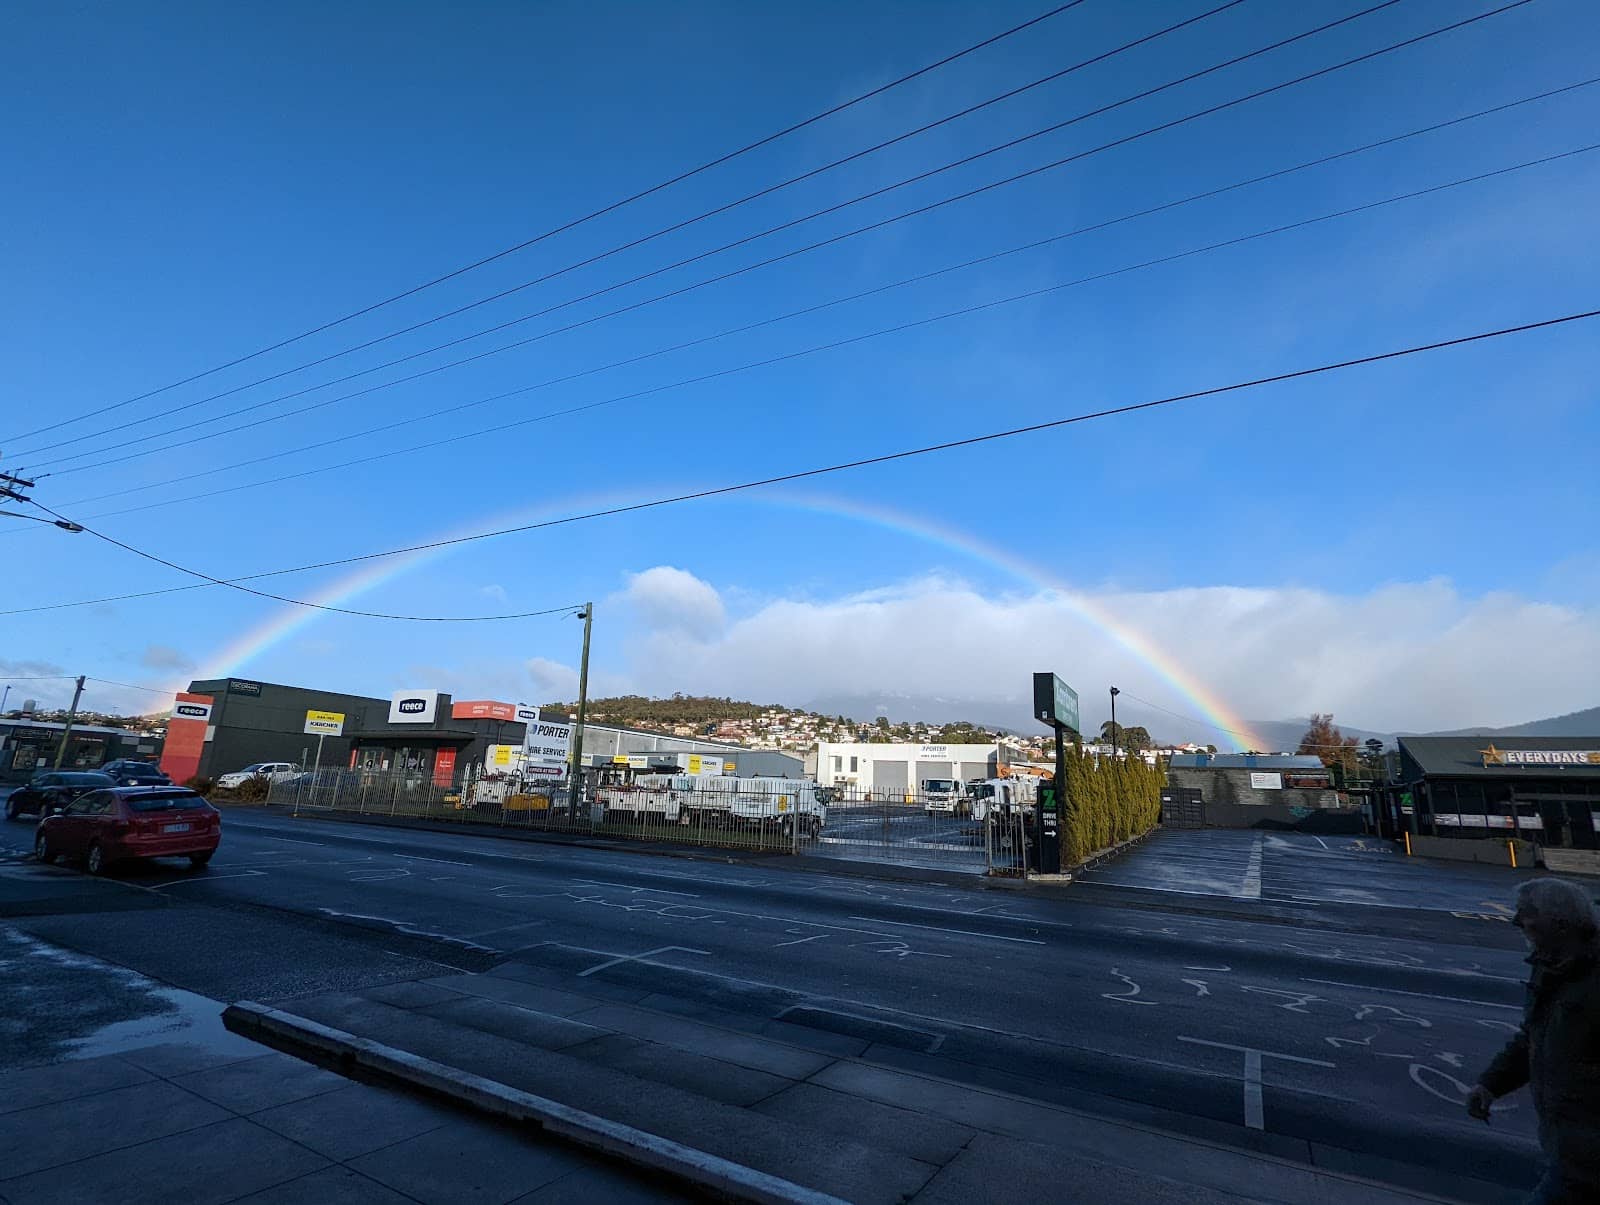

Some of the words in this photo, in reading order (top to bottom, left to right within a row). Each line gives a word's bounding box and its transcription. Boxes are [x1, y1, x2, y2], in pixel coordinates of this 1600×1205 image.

[180, 707, 205, 715] reece
[402, 702, 423, 711] reece
[537, 725, 570, 739] PORTER
[528, 745, 542, 755] HIRE
[543, 747, 566, 757] SERVICE
[1507, 752, 1588, 764] EVERYDAYS
[1043, 819, 1057, 827] THRU
